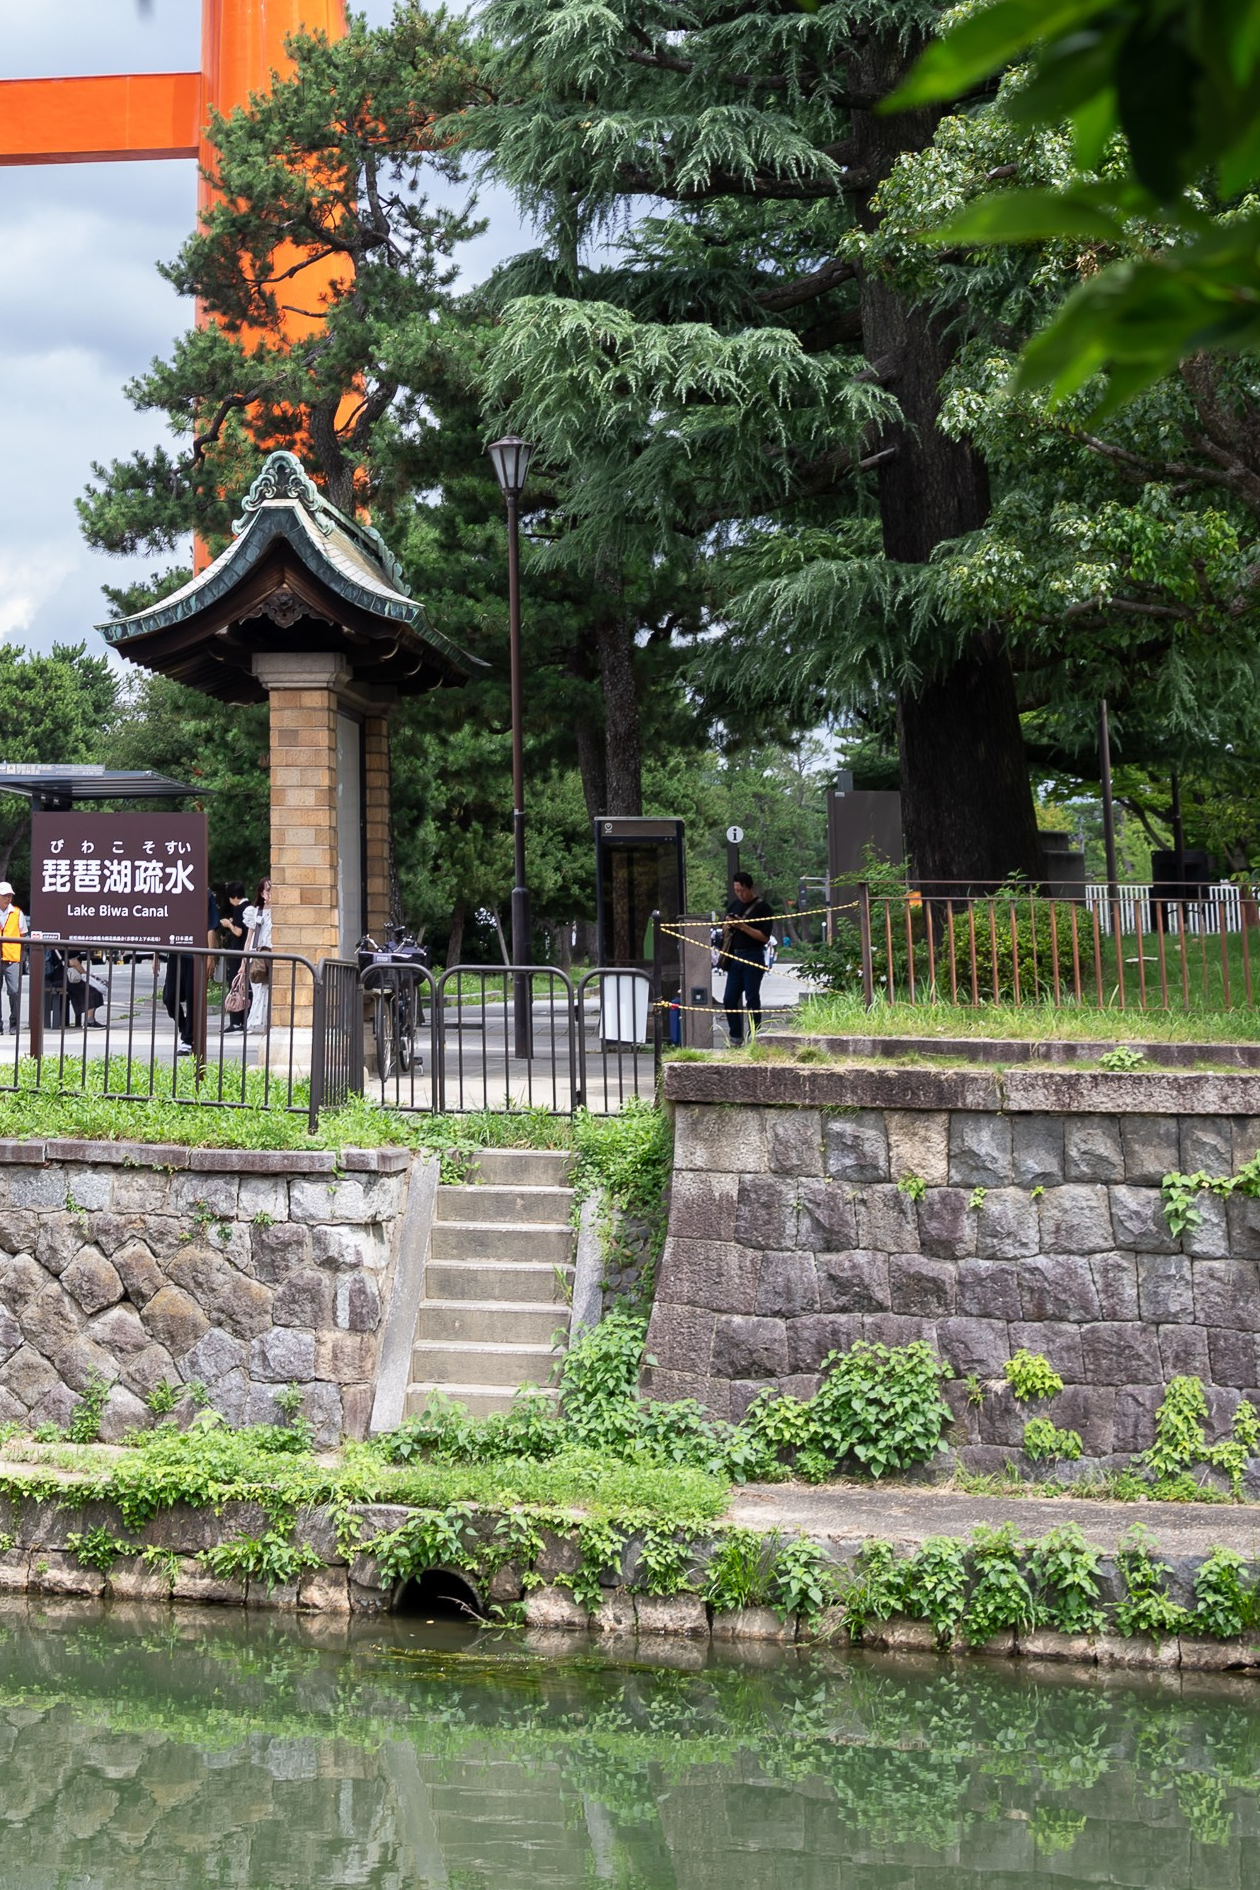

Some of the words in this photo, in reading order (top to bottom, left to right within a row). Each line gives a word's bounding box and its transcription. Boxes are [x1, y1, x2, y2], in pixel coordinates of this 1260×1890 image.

[41, 859, 195, 894] 琵琶湖疏水
[67, 904, 95, 917] Lake
[99, 904, 129, 917] Biwa
[132, 905, 169, 918] Canal
